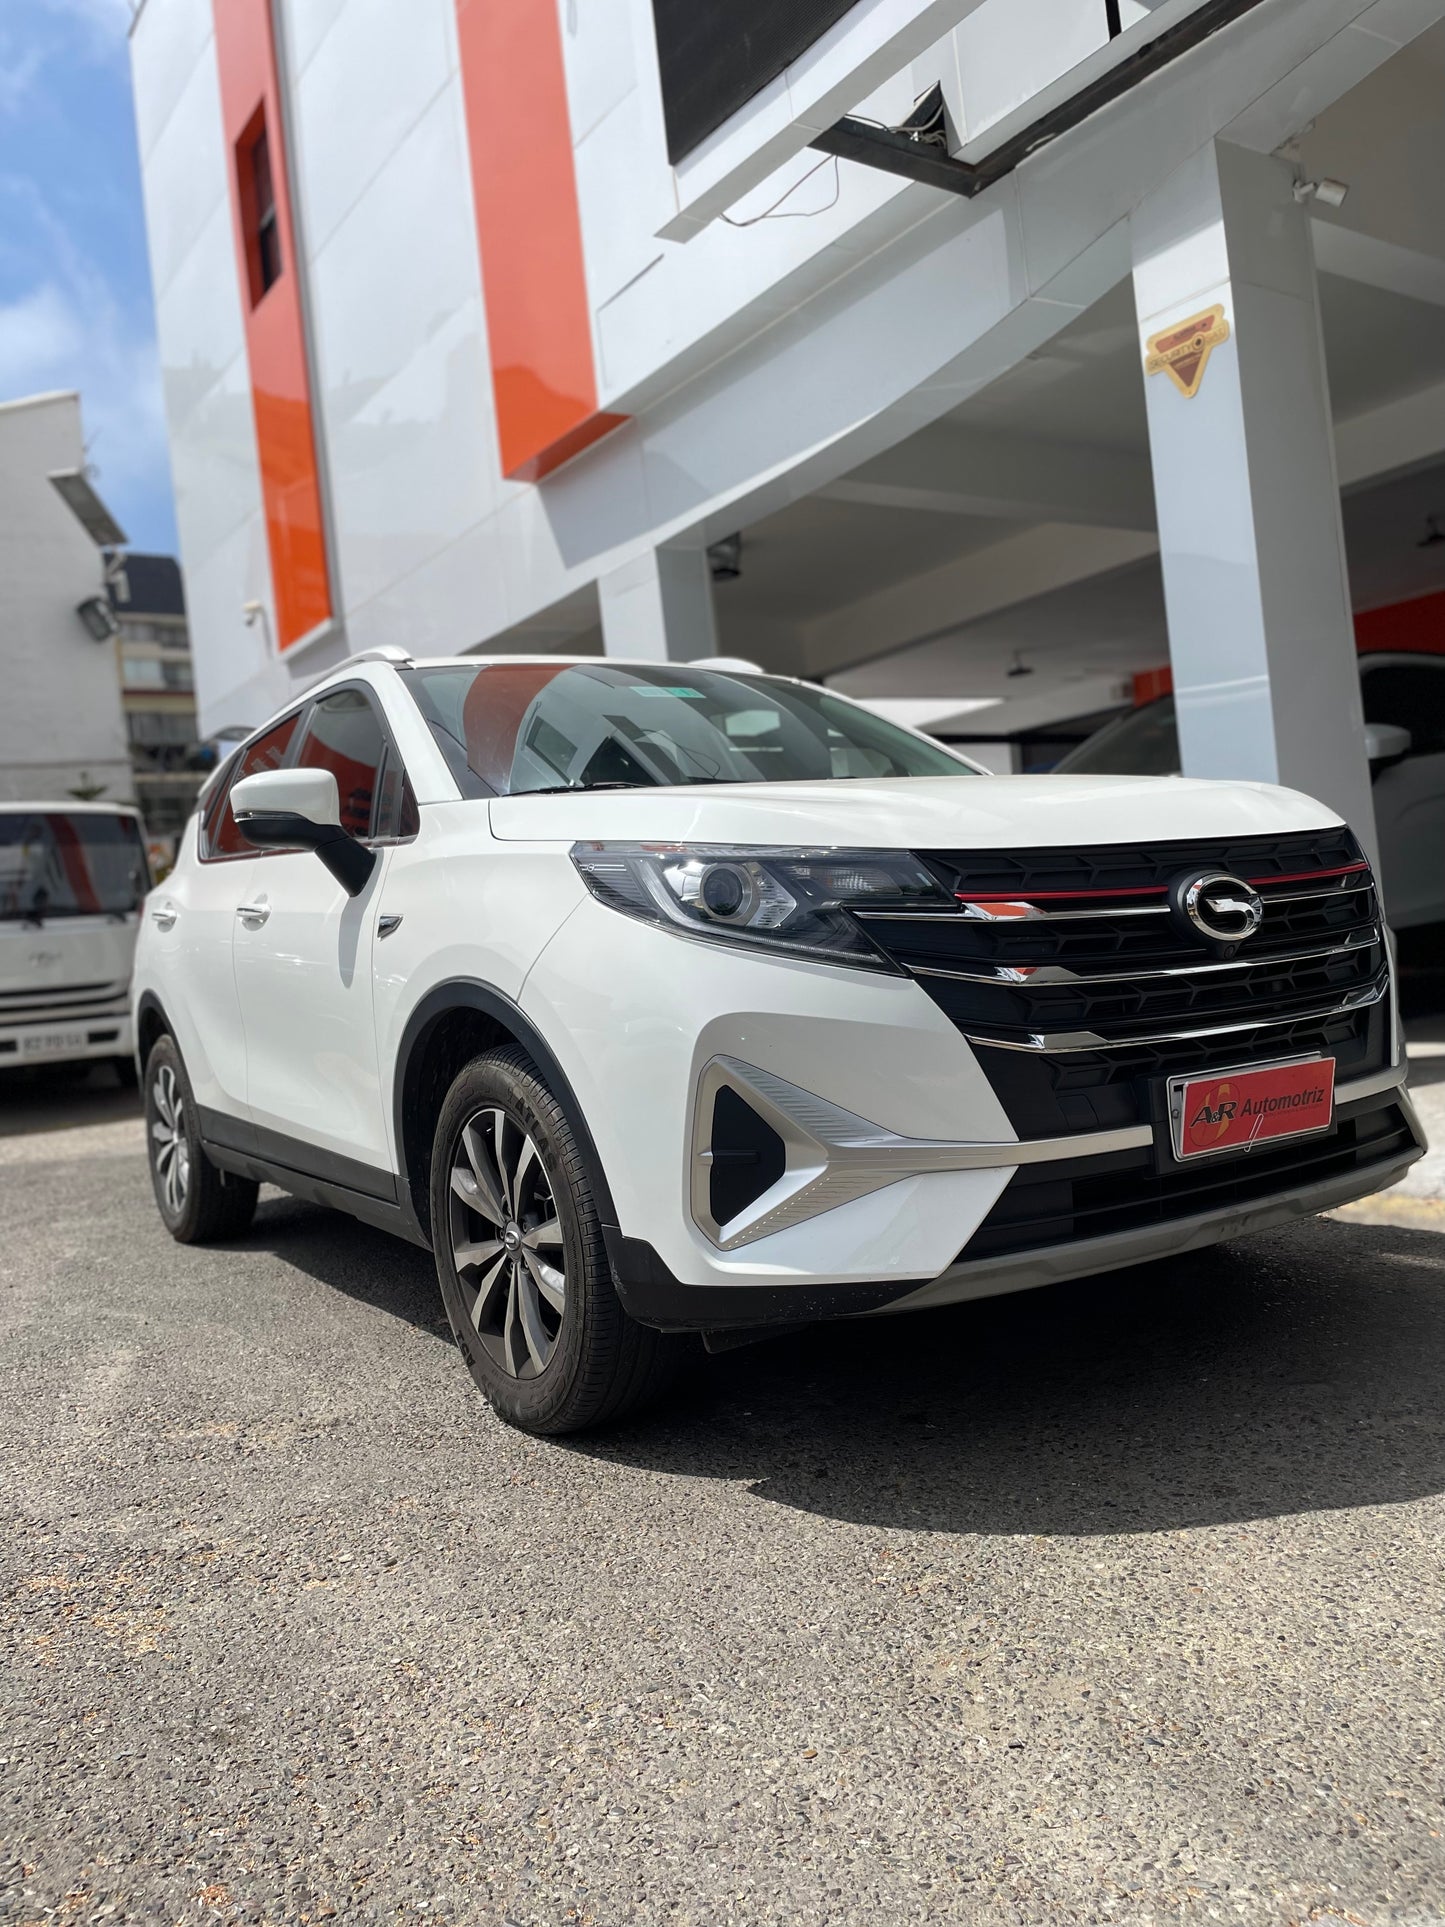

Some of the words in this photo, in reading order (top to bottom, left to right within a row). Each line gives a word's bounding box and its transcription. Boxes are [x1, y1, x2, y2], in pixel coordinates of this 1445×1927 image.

[515, 1097, 556, 1172] ATLAS
[1190, 1101, 1238, 1128] A&R
[1240, 1086, 1324, 1117] Automotriz
